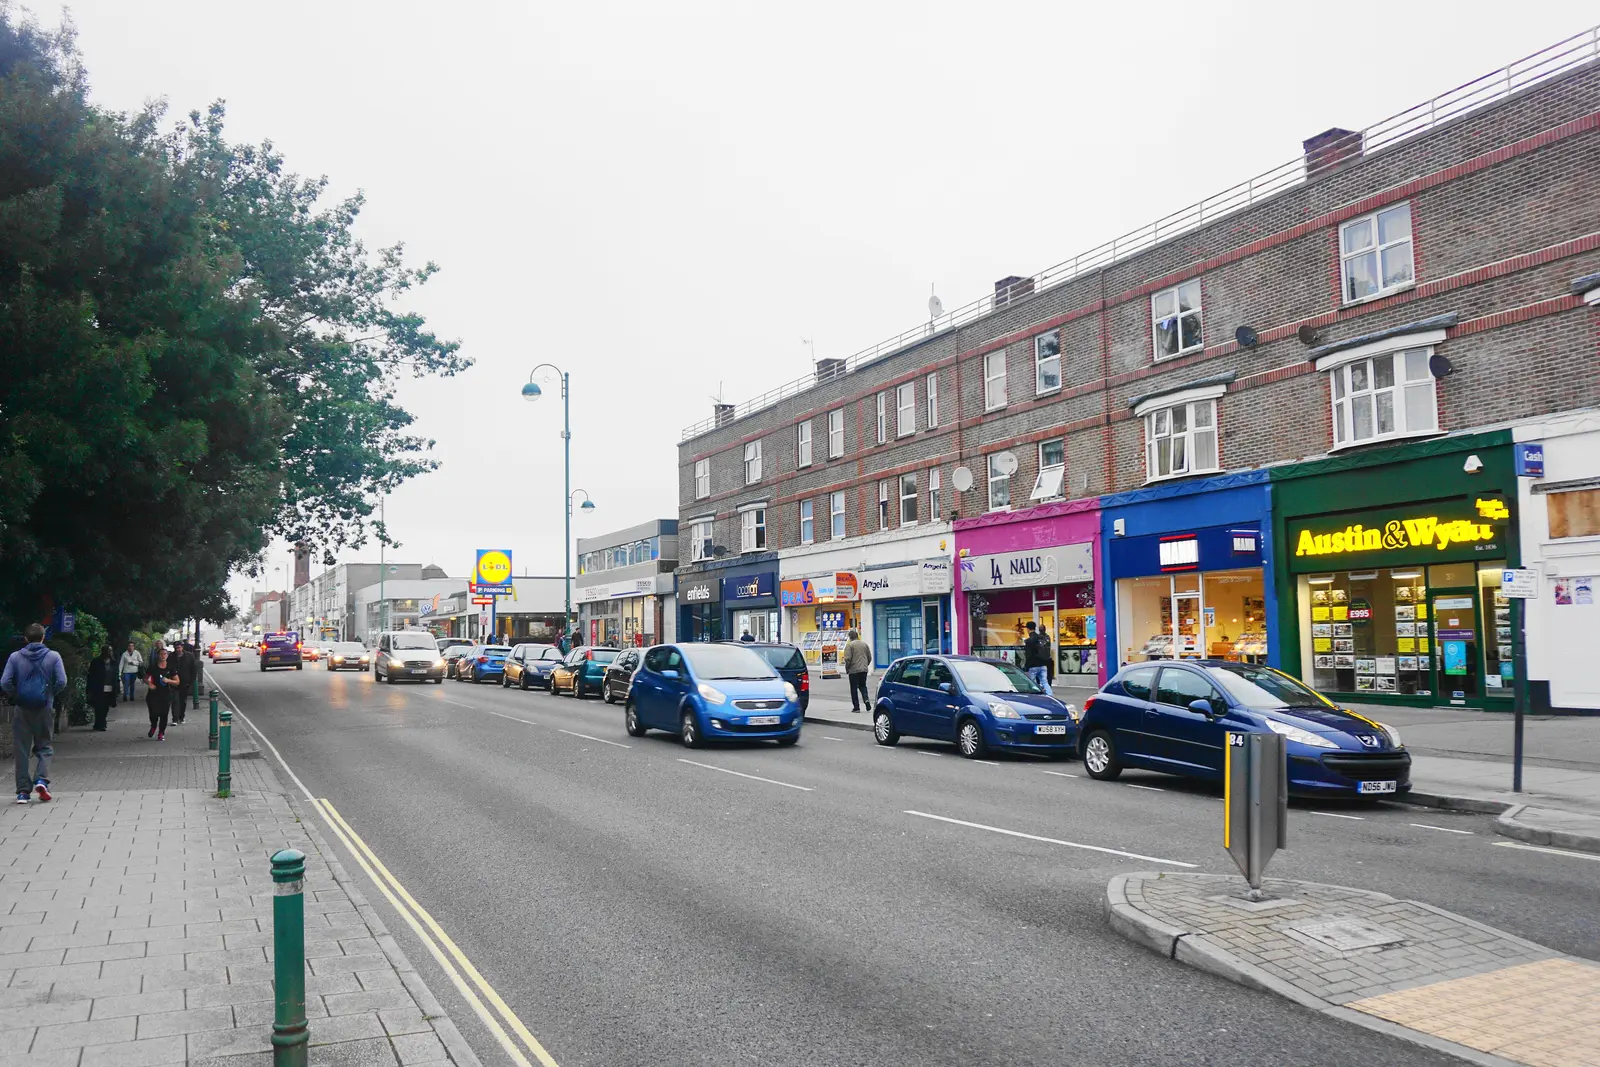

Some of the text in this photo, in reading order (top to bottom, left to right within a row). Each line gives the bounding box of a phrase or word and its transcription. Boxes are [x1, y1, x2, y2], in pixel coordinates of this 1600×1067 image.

[1524, 450, 1543, 462] Cash
[482, 561, 508, 571] LIDL
[1009, 557, 1042, 575] NAILS
[862, 578, 883, 591] Angel
[585, 588, 597, 597] TESCO
[687, 584, 710, 601] enfields
[1349, 609, 1370, 618] £995
[1229, 734, 1244, 746] 84
[1362, 781, 1381, 792] ND56
